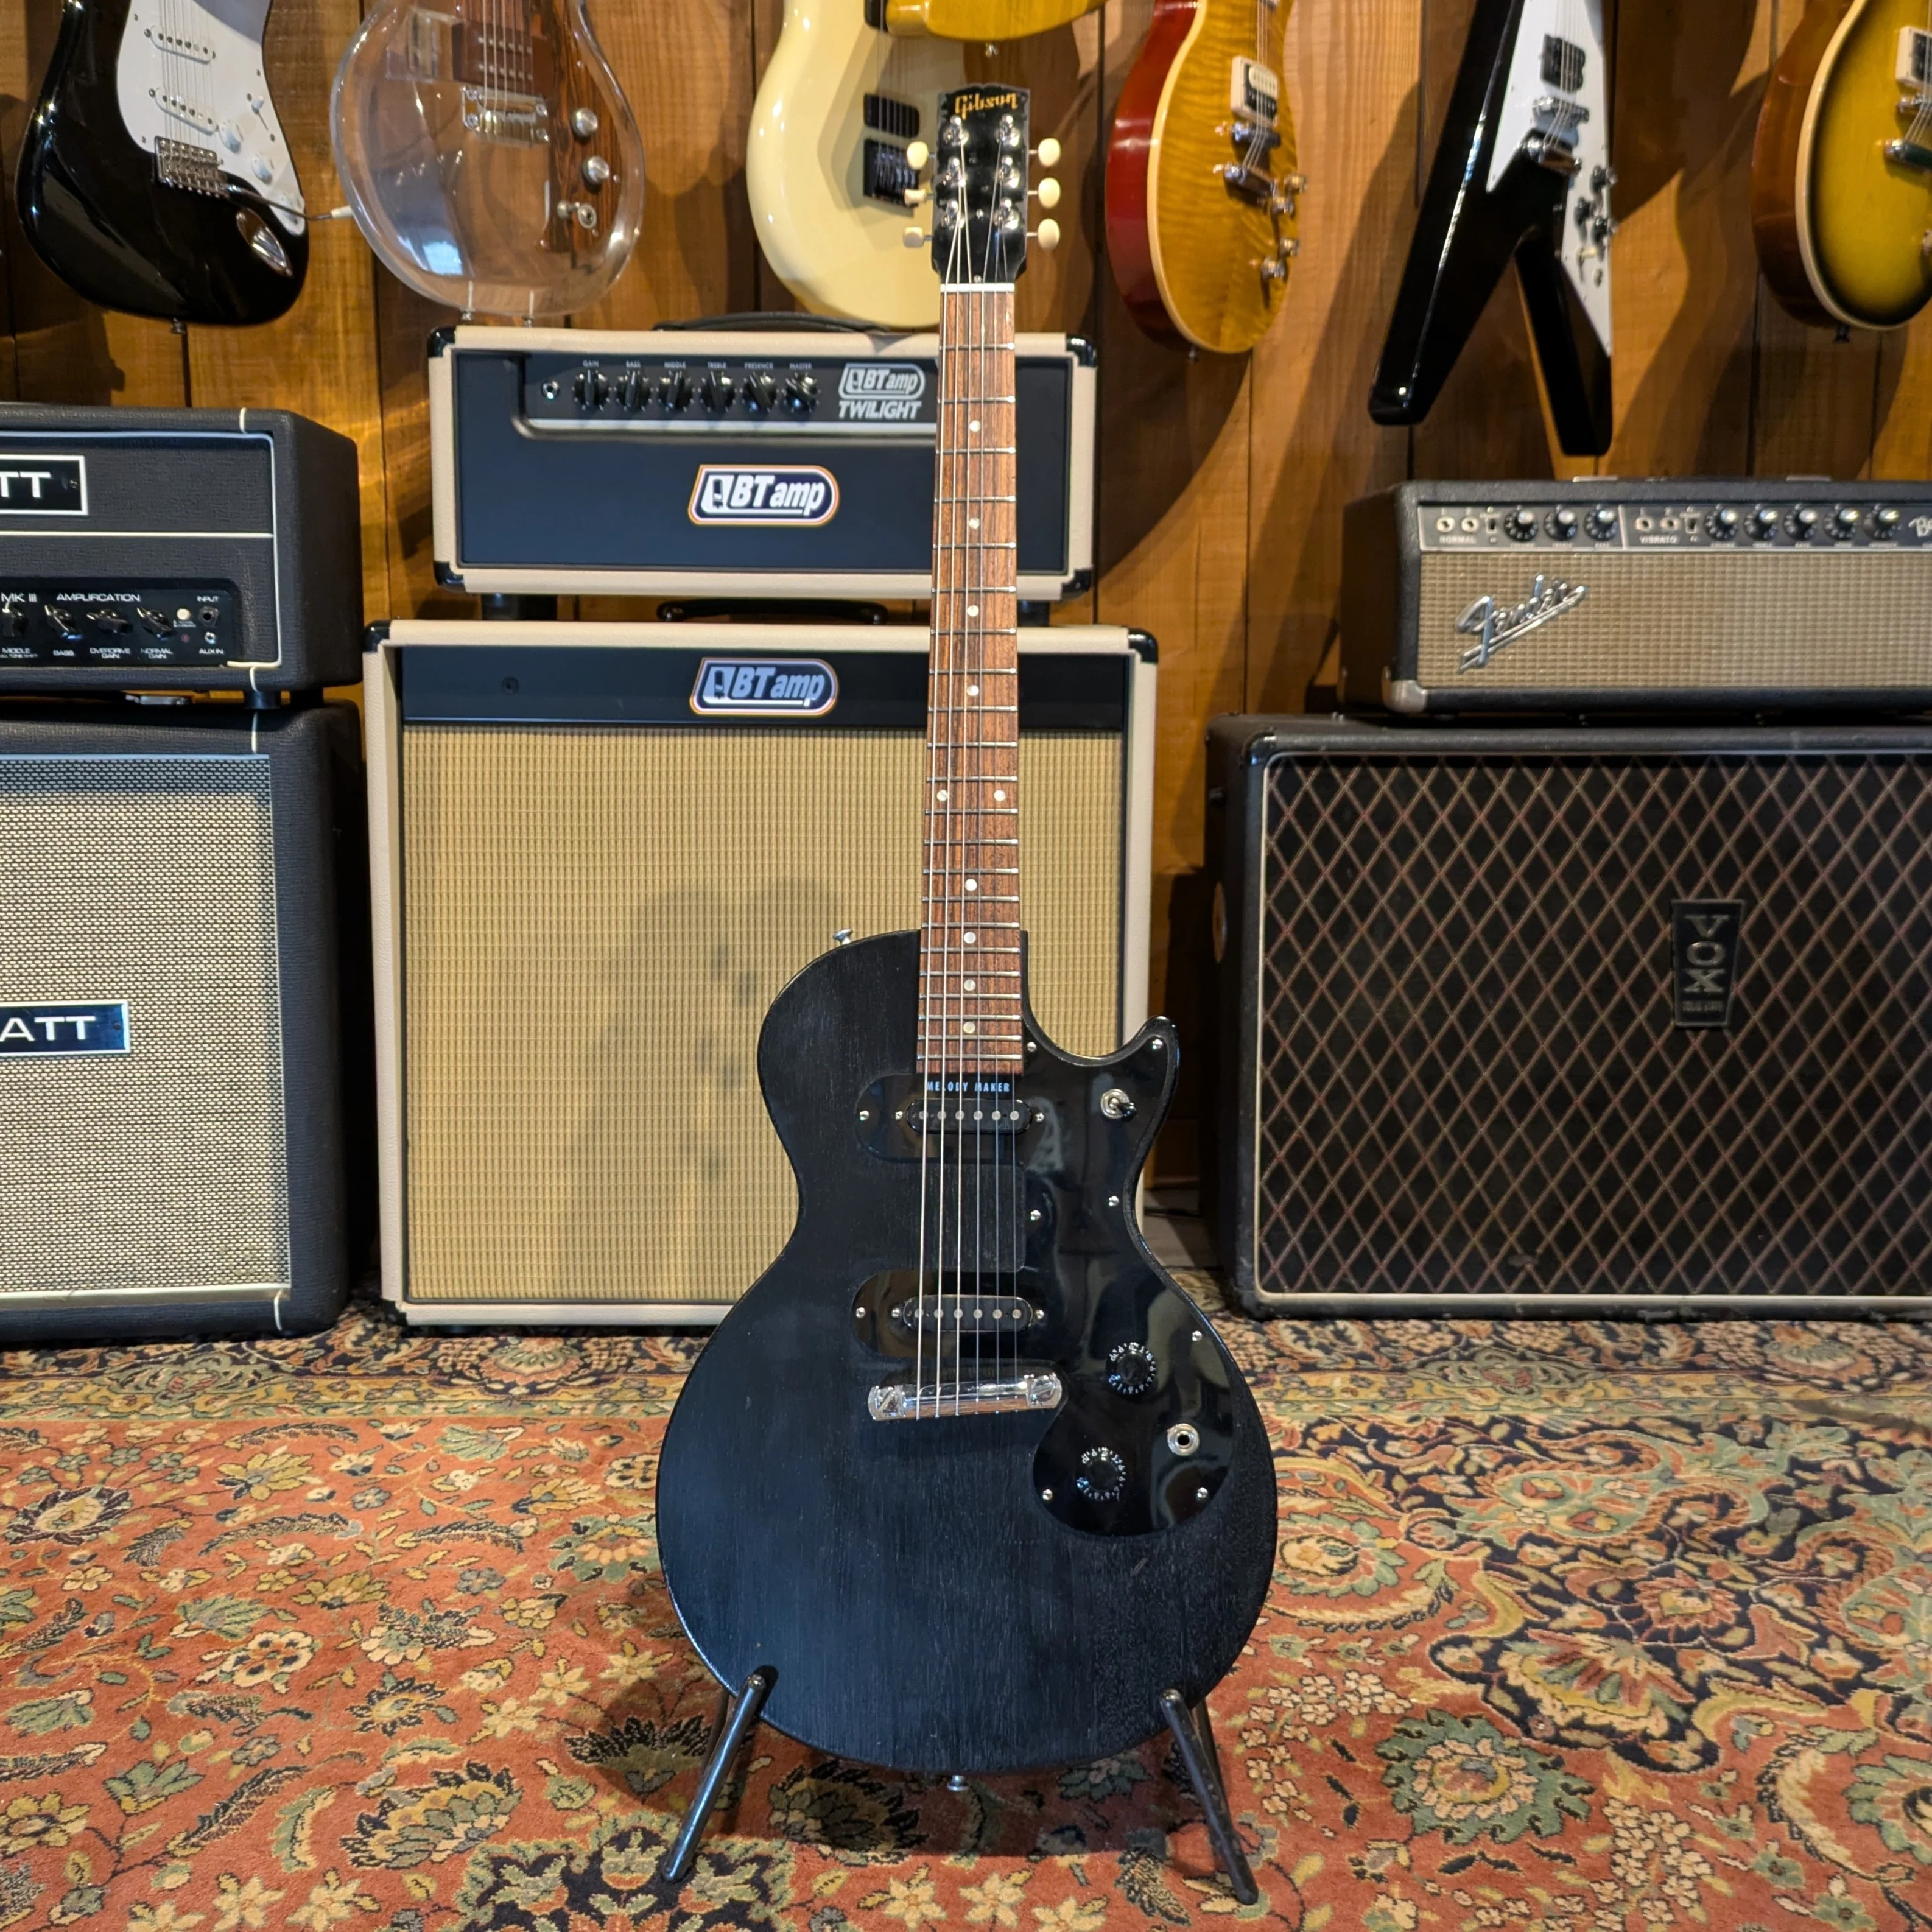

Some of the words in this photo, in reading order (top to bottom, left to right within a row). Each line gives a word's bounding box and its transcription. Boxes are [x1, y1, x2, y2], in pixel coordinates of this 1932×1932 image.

[955, 93, 1018, 120] Gibson
[839, 401, 922, 419] TWILIGHT
[1639, 535, 1680, 544] VIBRATO
[1, 592, 26, 602] MK
[57, 593, 141, 602] AMPLIFICATION
[1684, 915, 1730, 994] VOX
[0, 1016, 96, 1042] ATT
[927, 1081, 968, 1092] MEODY
[975, 1082, 1010, 1092] MAKER
